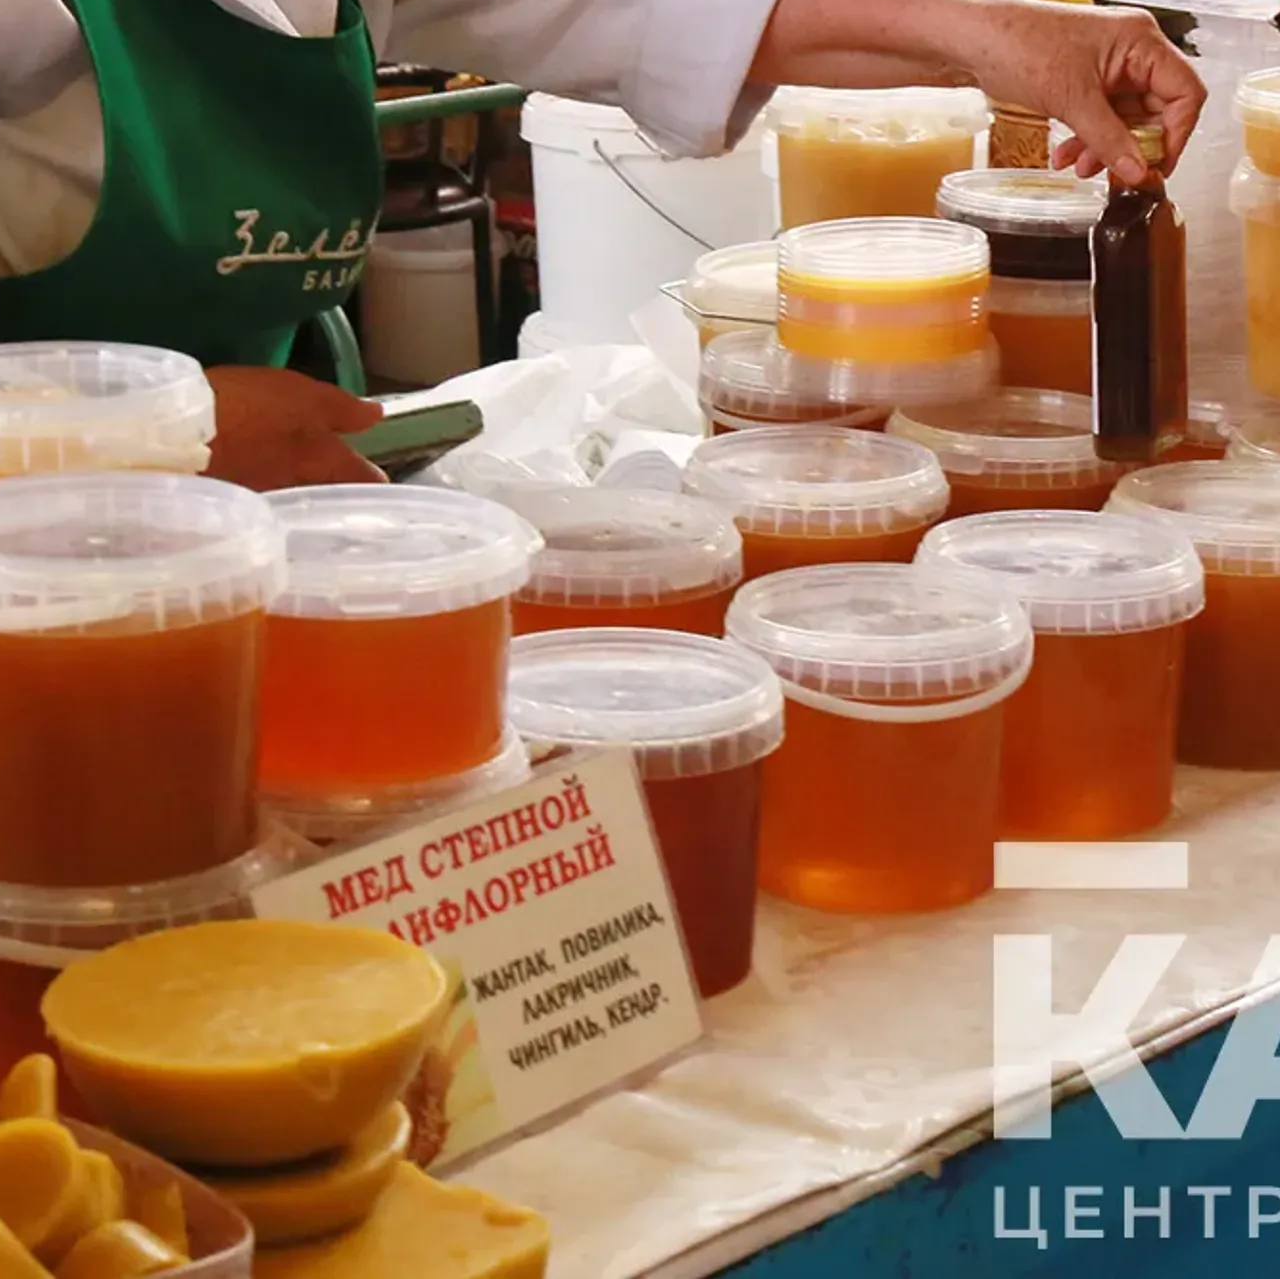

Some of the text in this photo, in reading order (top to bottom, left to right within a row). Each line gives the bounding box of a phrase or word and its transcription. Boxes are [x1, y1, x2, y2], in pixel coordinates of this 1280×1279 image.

[322, 773, 593, 920] МЕД СТЕПНОЙ
[560, 901, 665, 964] ПОВИЛИКА,
[522, 952, 640, 1025] ЛАКРИЧНИК,
[508, 1015, 606, 1071] ЧИНГИЛЬ,
